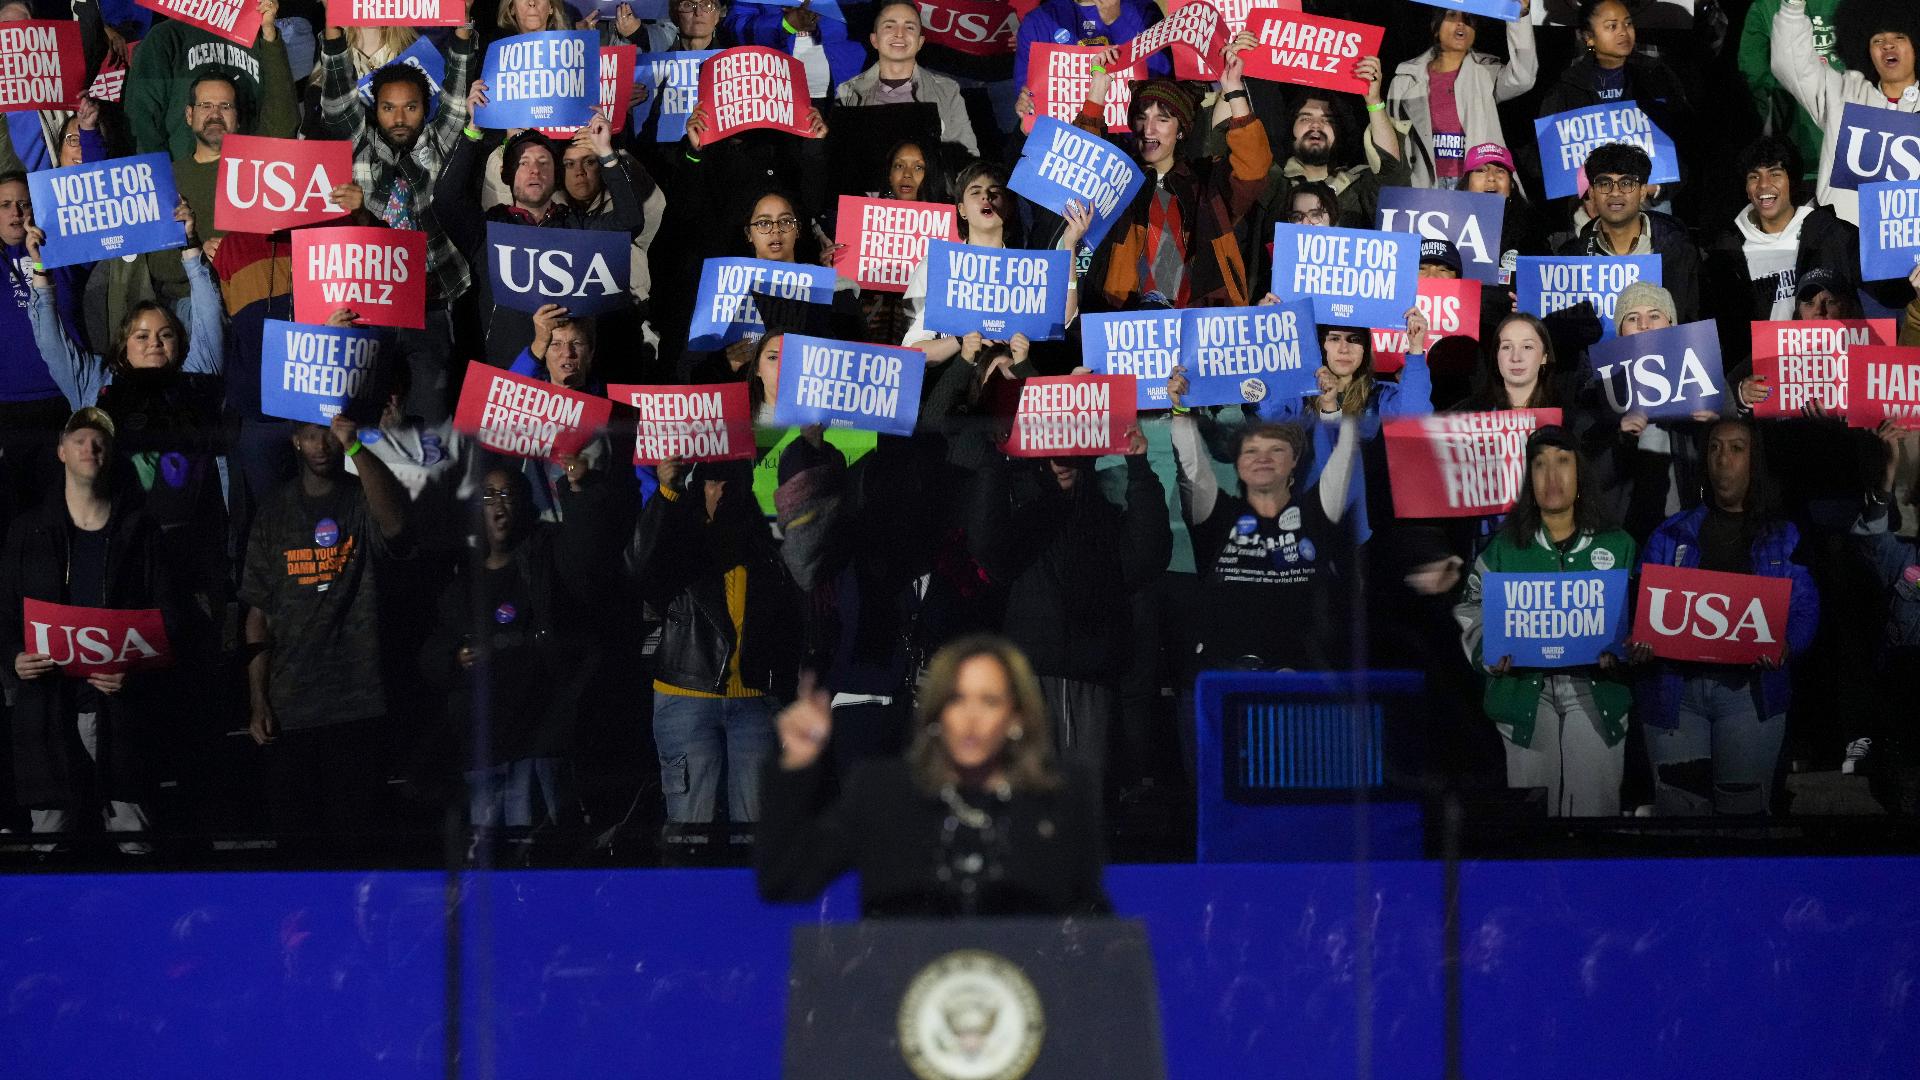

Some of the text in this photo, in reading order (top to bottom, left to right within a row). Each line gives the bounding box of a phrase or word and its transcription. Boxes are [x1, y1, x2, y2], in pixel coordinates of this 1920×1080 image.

[158, 0, 240, 32] EEDOM
[352, 0, 440, 20] FREEDOM
[917, 2, 1020, 42] USA
[0, 27, 58, 54] EDOM
[499, 38, 585, 71] VOTE FOR
[1130, 28, 1212, 63] FREEDOM
[1259, 19, 1362, 58] HARRIS
[0, 52, 62, 80] EDOM
[188, 42, 260, 85] OCEAN DRIVE
[652, 59, 699, 87] VOTE
[713, 52, 791, 84] FREEDOM
[1049, 51, 1134, 78] FREE
[1271, 48, 1341, 74] WALZ
[0, 77, 64, 106] EEDOM
[496, 69, 585, 101] FREEDOM
[713, 75, 793, 107] FREEDOM
[1048, 77, 1132, 102] FREEOM
[715, 98, 794, 133] FREEDOM
[1048, 101, 1129, 127] FREOM
[1555, 106, 1651, 145] VOTE FOR
[1433, 134, 1465, 149] HARRI
[1438, 148, 1464, 158] WALZ
[1560, 132, 1655, 171] FREM
[1847, 126, 1920, 182] US
[1051, 127, 1133, 196] VOTE FOR
[51, 163, 156, 208] VOTE FOR
[225, 157, 346, 213] USA
[1037, 150, 1120, 220] FREEDOM
[56, 191, 160, 237] FREEDOM
[1879, 188, 1920, 220] VOT
[862, 204, 951, 238] FREEDOM
[1879, 217, 1920, 250] FREE
[860, 231, 931, 261] FREEDO
[1297, 233, 1398, 271] VOTE FOR
[308, 243, 409, 283] HARRIS
[494, 244, 624, 297] USA
[858, 256, 921, 286] FREED
[949, 250, 1049, 287] VOTE FOR
[1539, 263, 1640, 293] VOTE FOR
[322, 283, 393, 305] WALZ
[717, 265, 813, 303] VOTE FOR
[946, 278, 1047, 314] FREEDOM
[1293, 264, 1396, 300] FREEDOM
[711, 294, 764, 324] FREE
[1331, 303, 1354, 315] HARRIS
[1334, 311, 1350, 319] WALZ
[1414, 294, 1460, 332] RIS
[1540, 291, 1618, 320] FREDO
[1104, 319, 1160, 351] VOTE
[1196, 314, 1251, 348] VOTE
[1254, 310, 1298, 342] FOR
[1372, 331, 1443, 354] WAZ
[1777, 327, 1869, 355] FREEDOM
[286, 330, 380, 369] VOTE FOR
[1106, 347, 1181, 379] FREED
[1197, 339, 1302, 377] FREEDOM
[282, 361, 375, 400] FREEDO
[801, 344, 902, 389] VOTE FOR
[1597, 347, 1719, 413] USA
[1778, 354, 1848, 384] FREEDO
[1867, 362, 1920, 402] HAR
[487, 375, 585, 429] FREEDOM
[631, 391, 723, 420] FREEDOM
[796, 375, 899, 420] FREEDOM
[1018, 382, 1110, 413] FREEDOM
[1147, 386, 1169, 396] HARRI
[1779, 382, 1848, 411] FREEDO
[480, 402, 566, 445] FREEDO
[1020, 421, 1110, 450] FREEDOM
[635, 432, 729, 460] FREEDOM
[1443, 461, 1525, 508] FREEDO
[1504, 579, 1605, 609] VOTE FOR
[1504, 608, 1605, 639] FREEDOM
[1646, 586, 1776, 643] USA
[30, 620, 160, 665] USA
